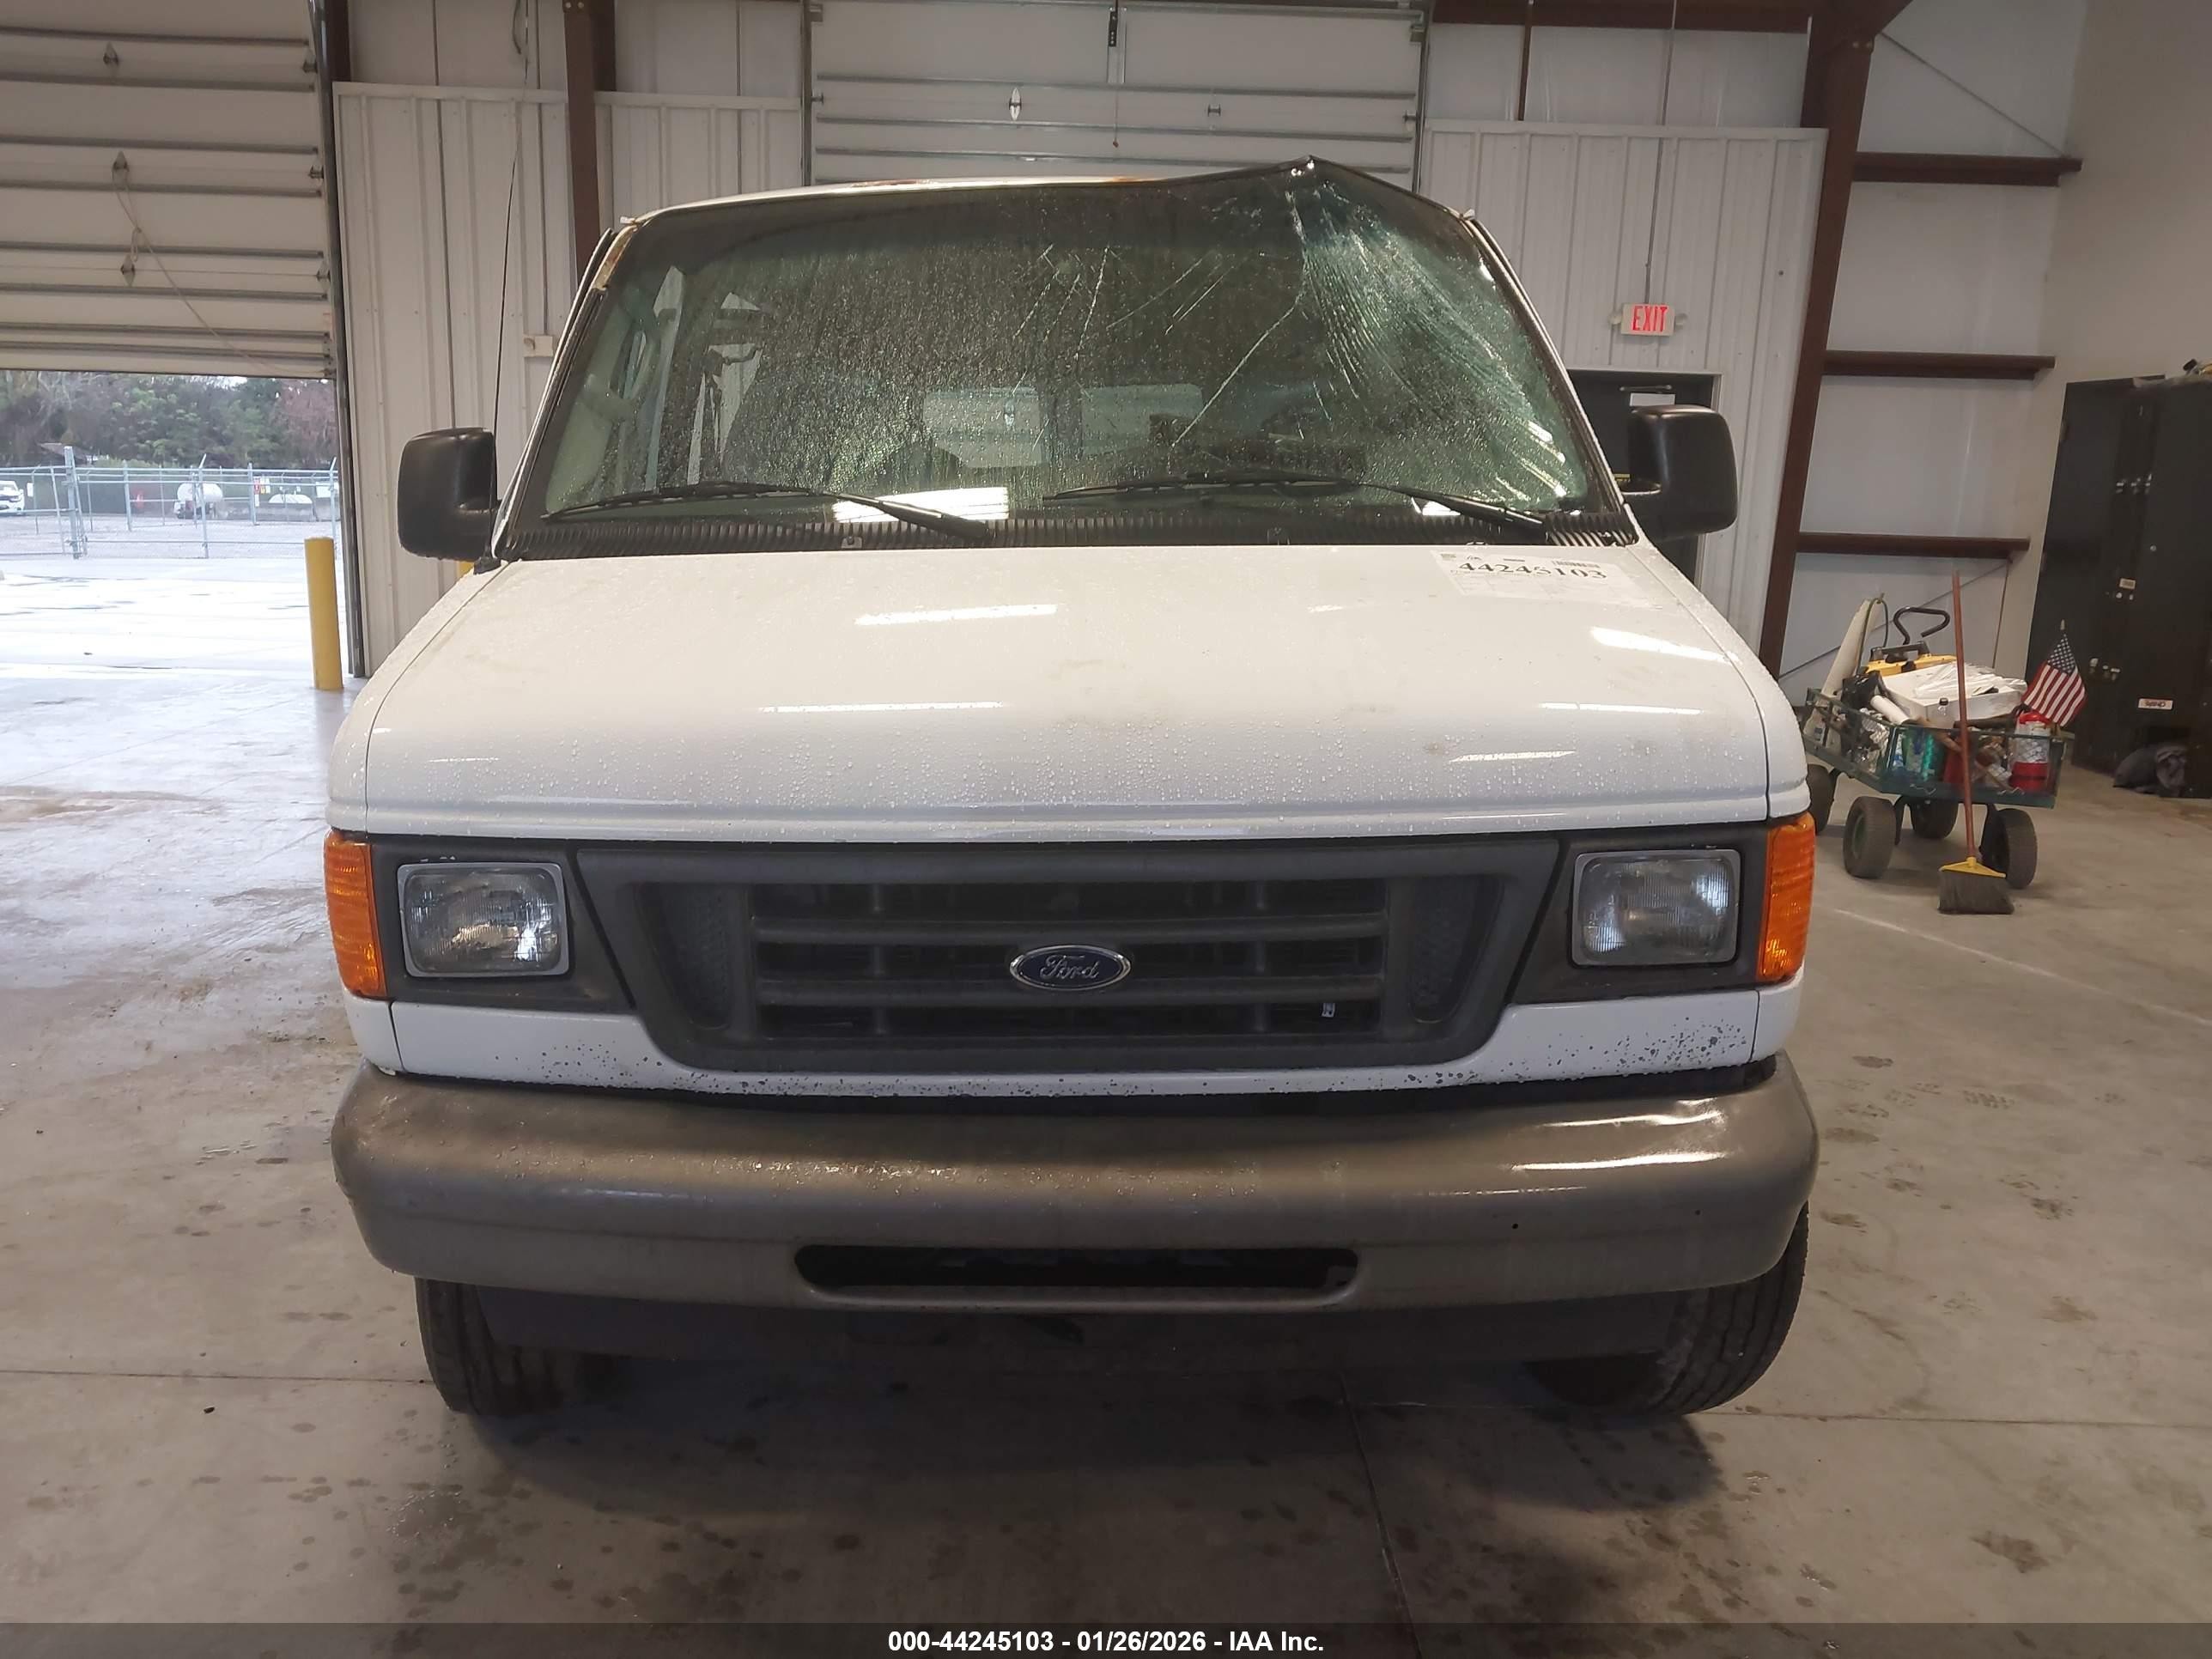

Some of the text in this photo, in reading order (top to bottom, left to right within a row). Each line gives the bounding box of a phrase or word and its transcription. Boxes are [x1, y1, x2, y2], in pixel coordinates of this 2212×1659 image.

[1632, 305, 1668, 332] EXIT
[1459, 562, 1607, 579] 44245103
[1040, 954, 1100, 979] Ford
